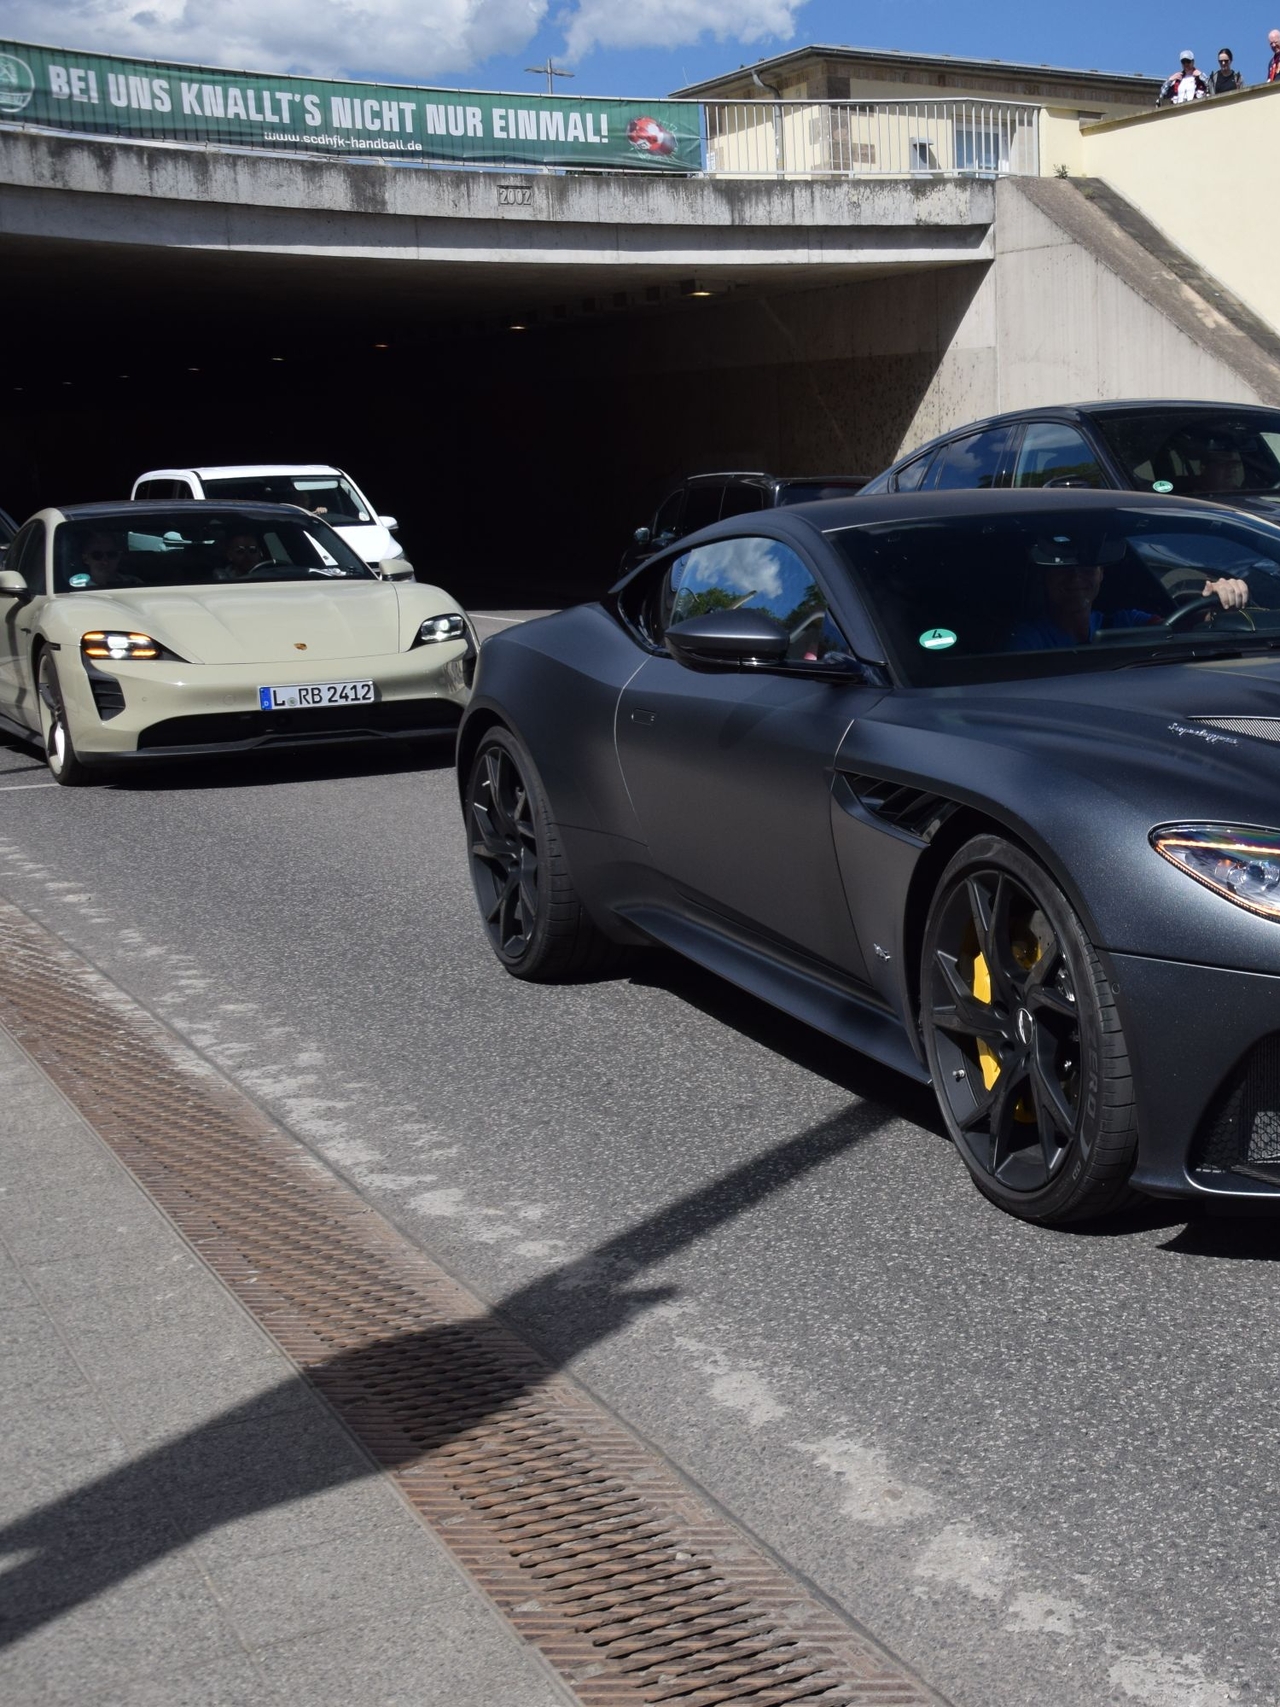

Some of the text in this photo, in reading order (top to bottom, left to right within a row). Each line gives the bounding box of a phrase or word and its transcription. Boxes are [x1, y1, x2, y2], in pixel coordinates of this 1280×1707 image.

[48, 65, 608, 143] BEI UNS KNALLT'S NICHT NUR EINMAL!
[264, 132, 423, 151] www.scdhfk-handball.de
[500, 188, 532, 206] 2002
[932, 630, 943, 639] 4
[273, 684, 372, 707] L RB 2412
